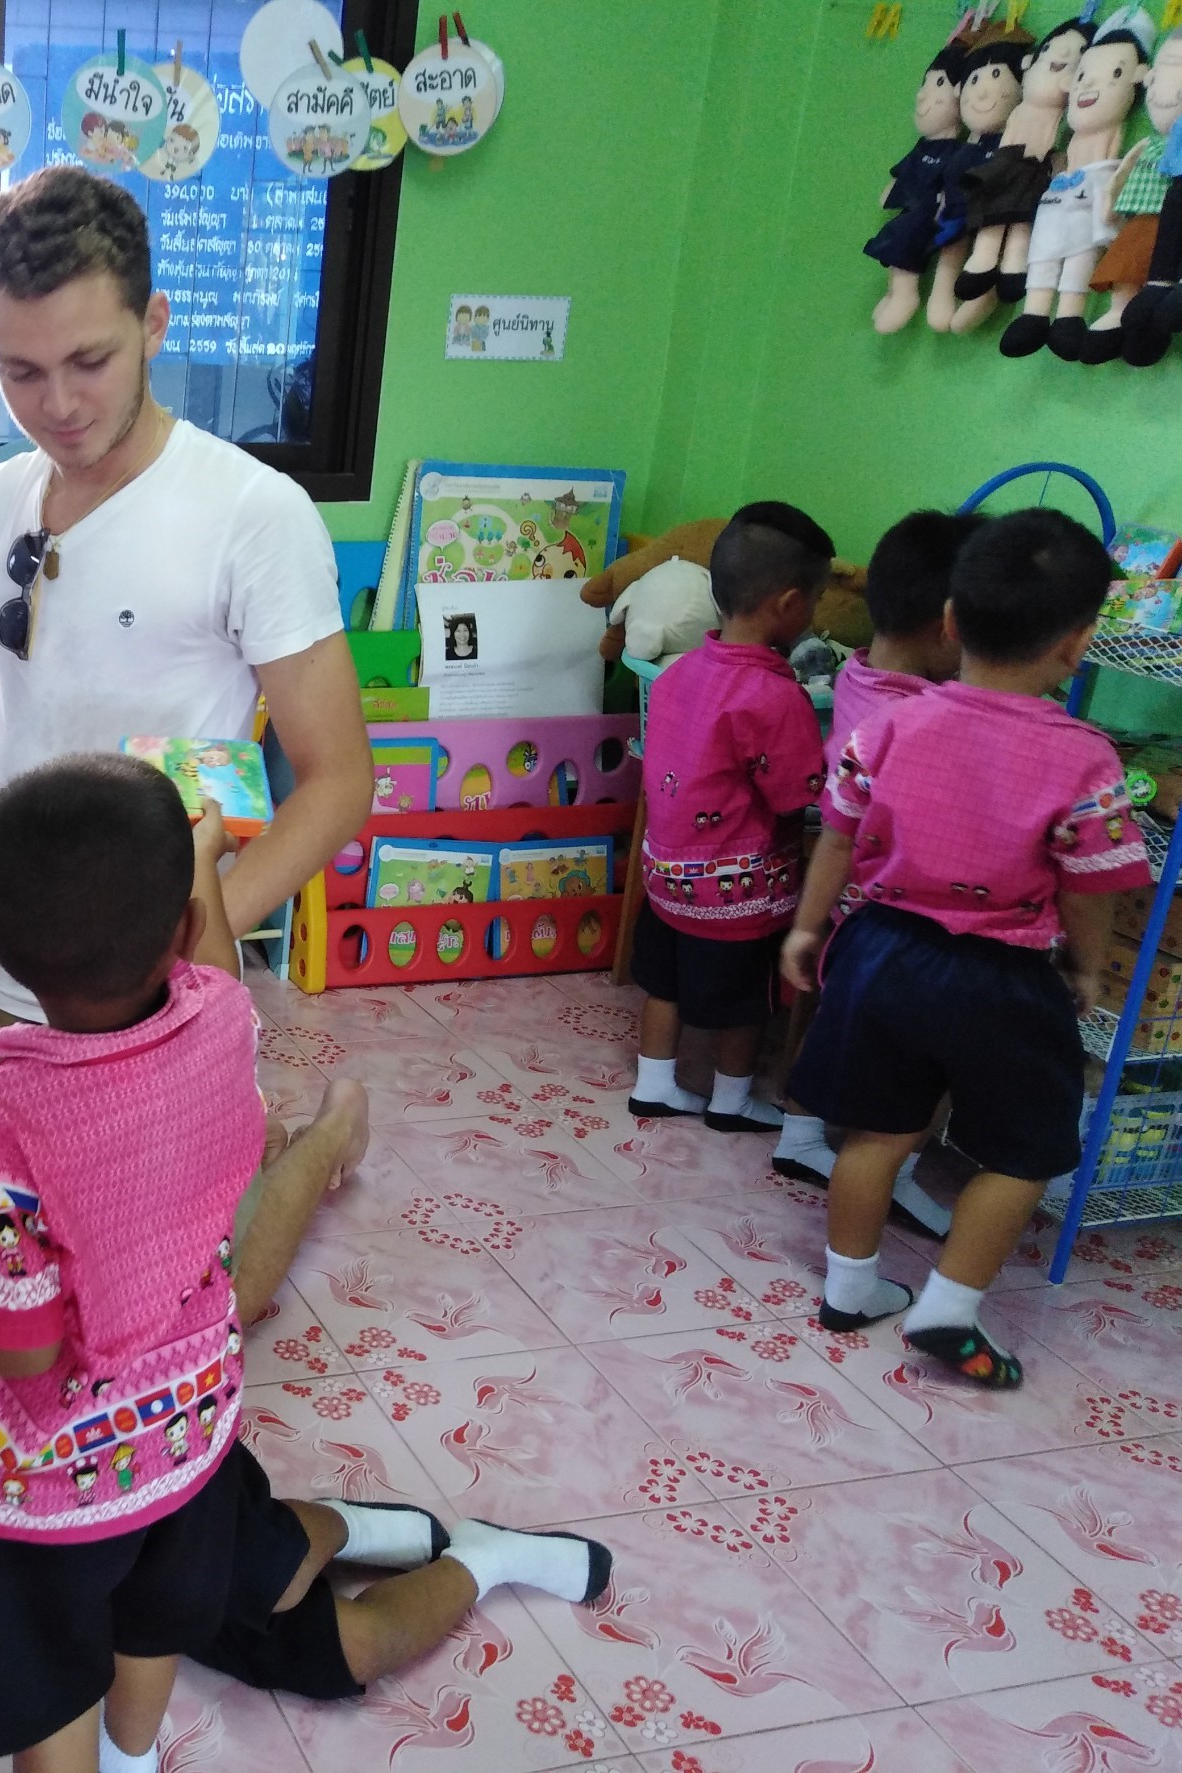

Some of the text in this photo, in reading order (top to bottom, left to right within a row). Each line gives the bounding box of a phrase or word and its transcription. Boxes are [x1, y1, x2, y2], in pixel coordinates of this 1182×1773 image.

[415, 67, 477, 93] สะอาด
[85, 72, 153, 116] มีนำใจ
[287, 86, 355, 115] สามัคคี
[492, 312, 555, 337] ศูนย์นิทาน
